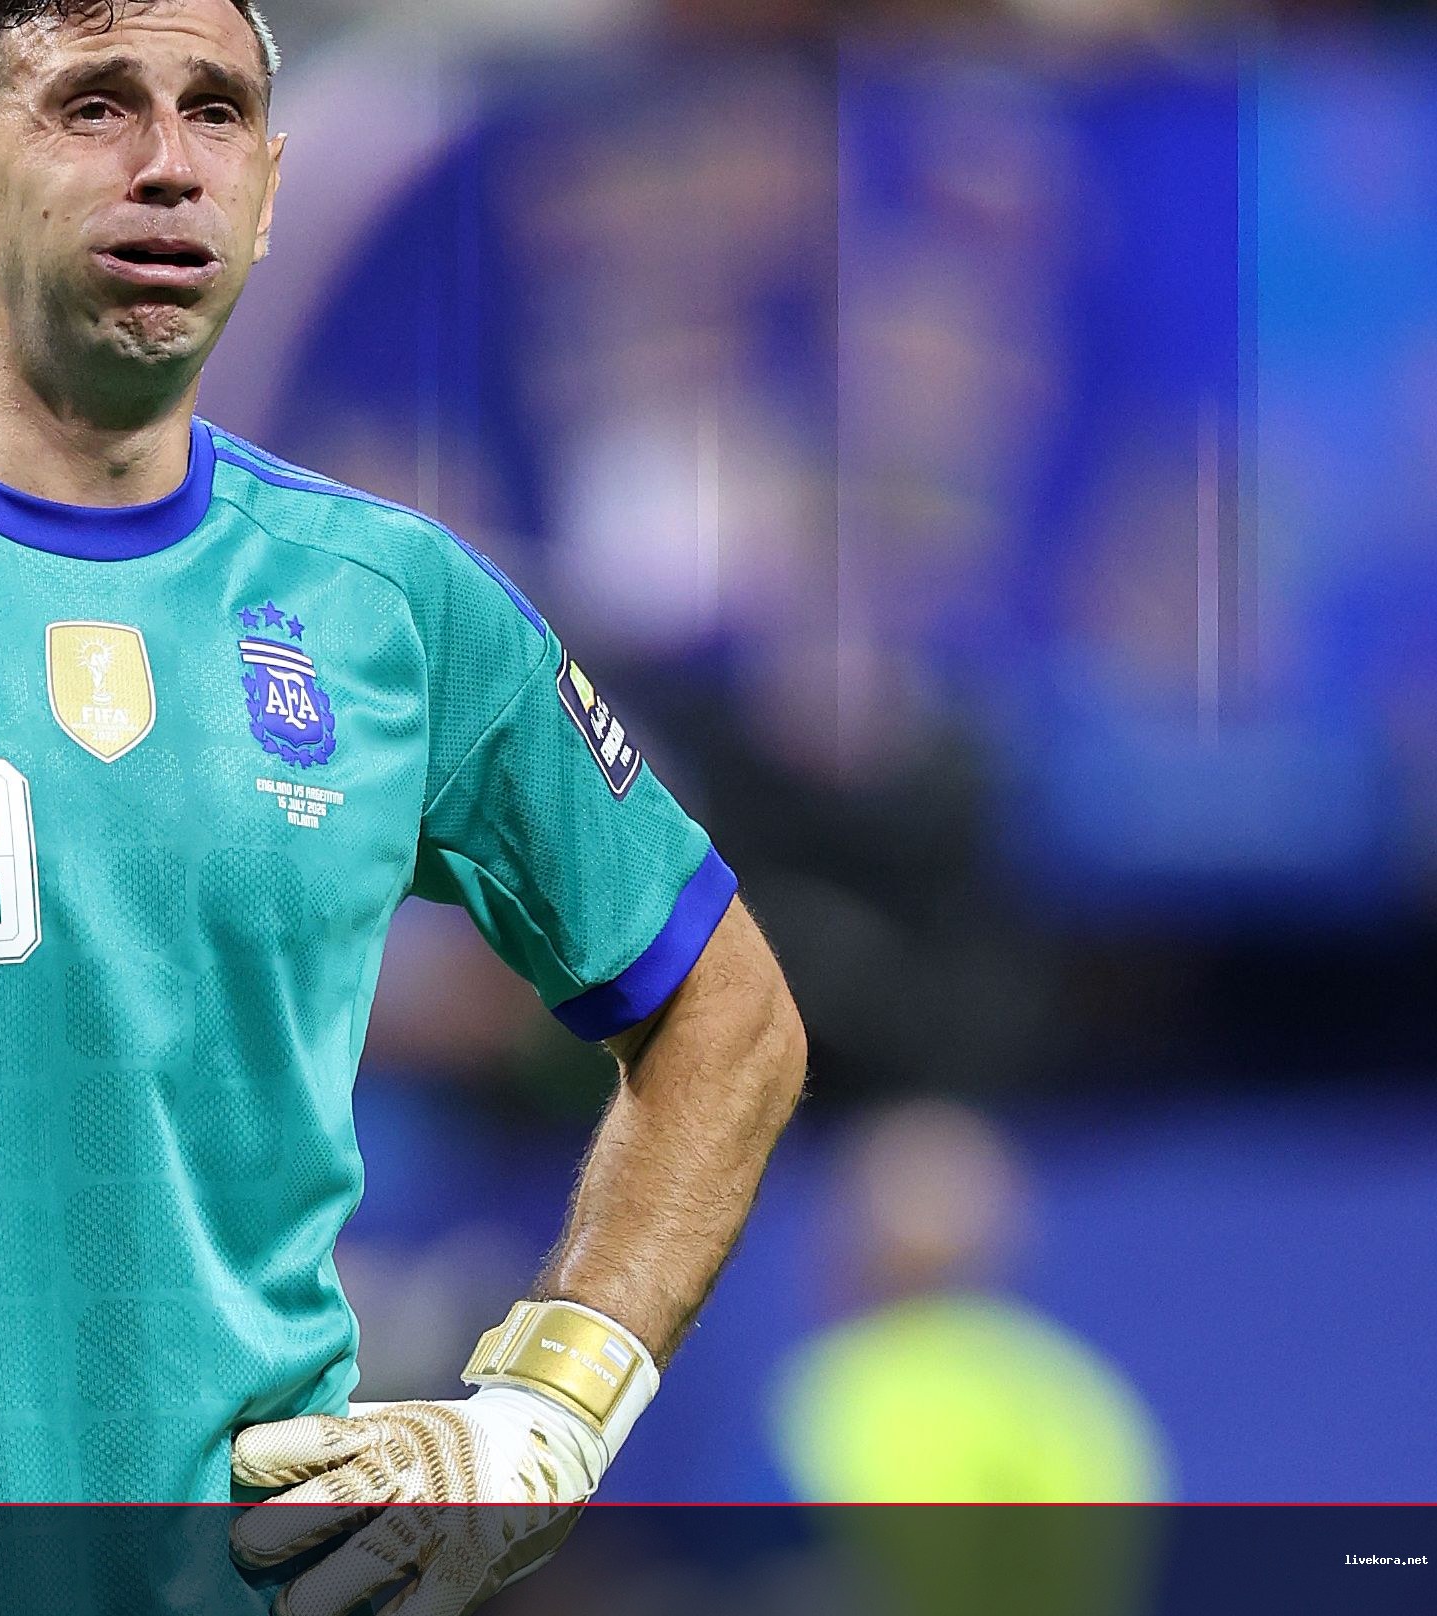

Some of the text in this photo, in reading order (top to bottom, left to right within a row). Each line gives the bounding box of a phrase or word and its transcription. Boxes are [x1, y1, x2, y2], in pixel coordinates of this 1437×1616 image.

[265, 666, 320, 730] AFA
[82, 705, 128, 723] FIFA
[256, 778, 293, 796] ENGLAND
[294, 783, 305, 797] VS
[288, 798, 306, 811] JULY
[541, 1338, 566, 1353] AVA
